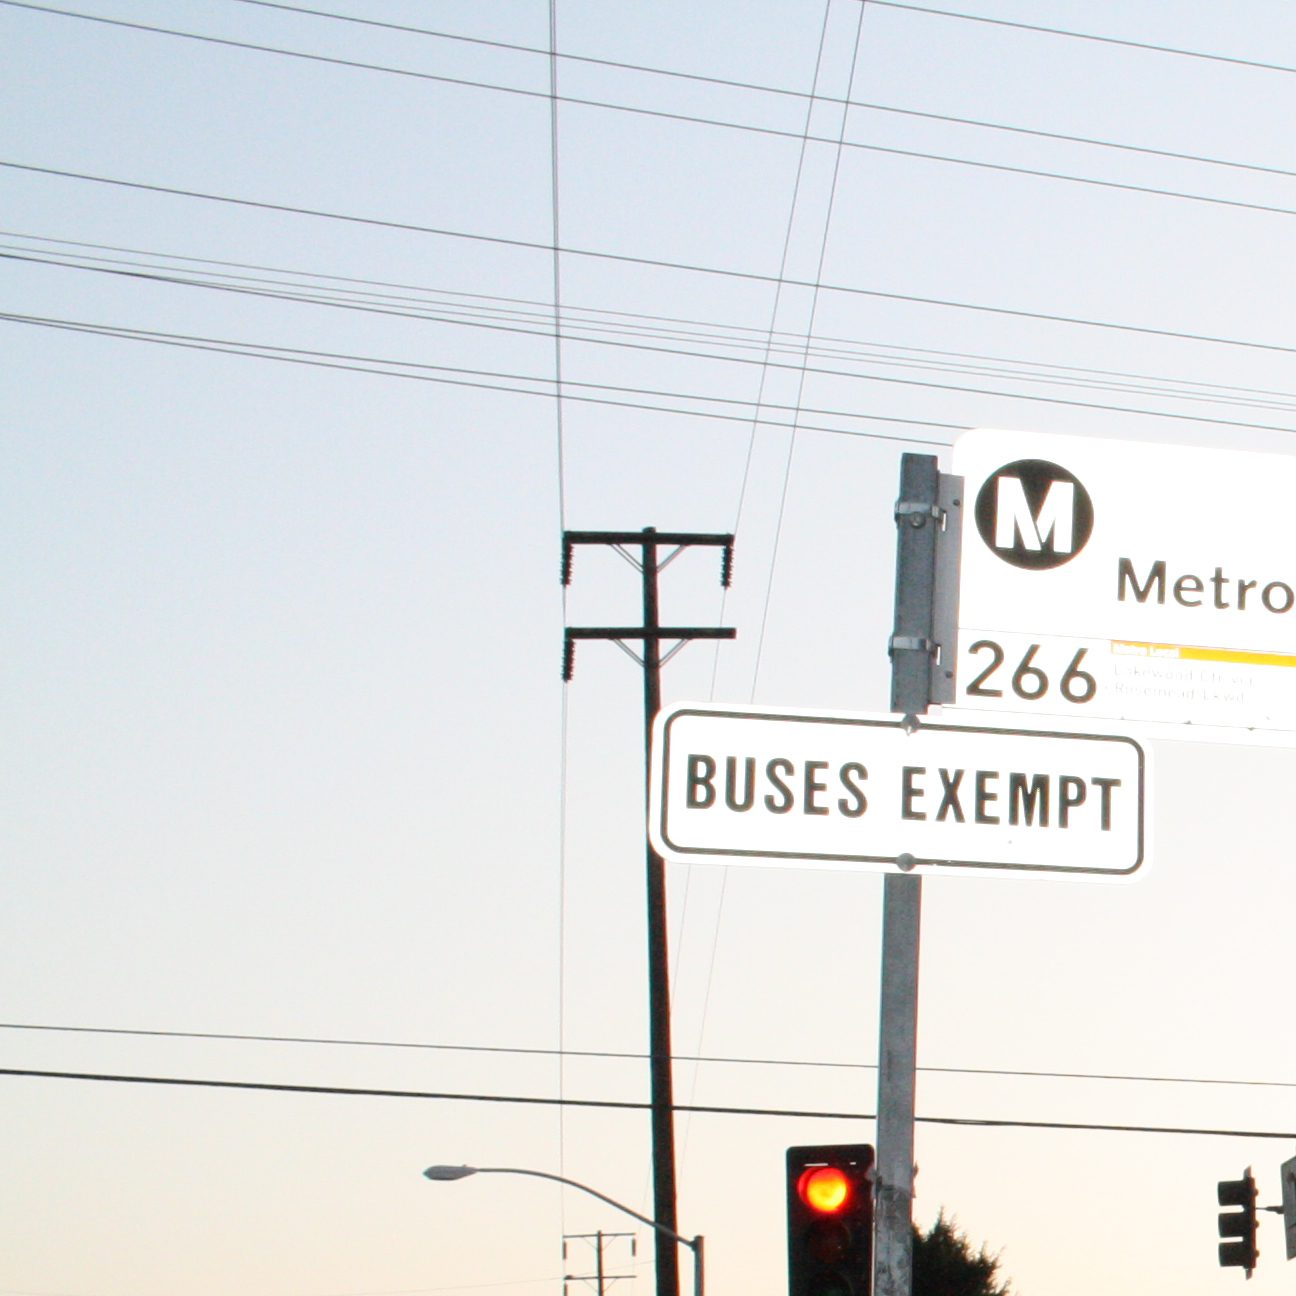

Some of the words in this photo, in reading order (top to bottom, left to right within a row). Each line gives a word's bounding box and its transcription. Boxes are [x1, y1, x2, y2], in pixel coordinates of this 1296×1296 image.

[1116, 556, 1295, 614] Metro
[964, 639, 1098, 704] 266
[685, 754, 869, 818] BUSES
[901, 766, 1122, 832] EXEMPT
